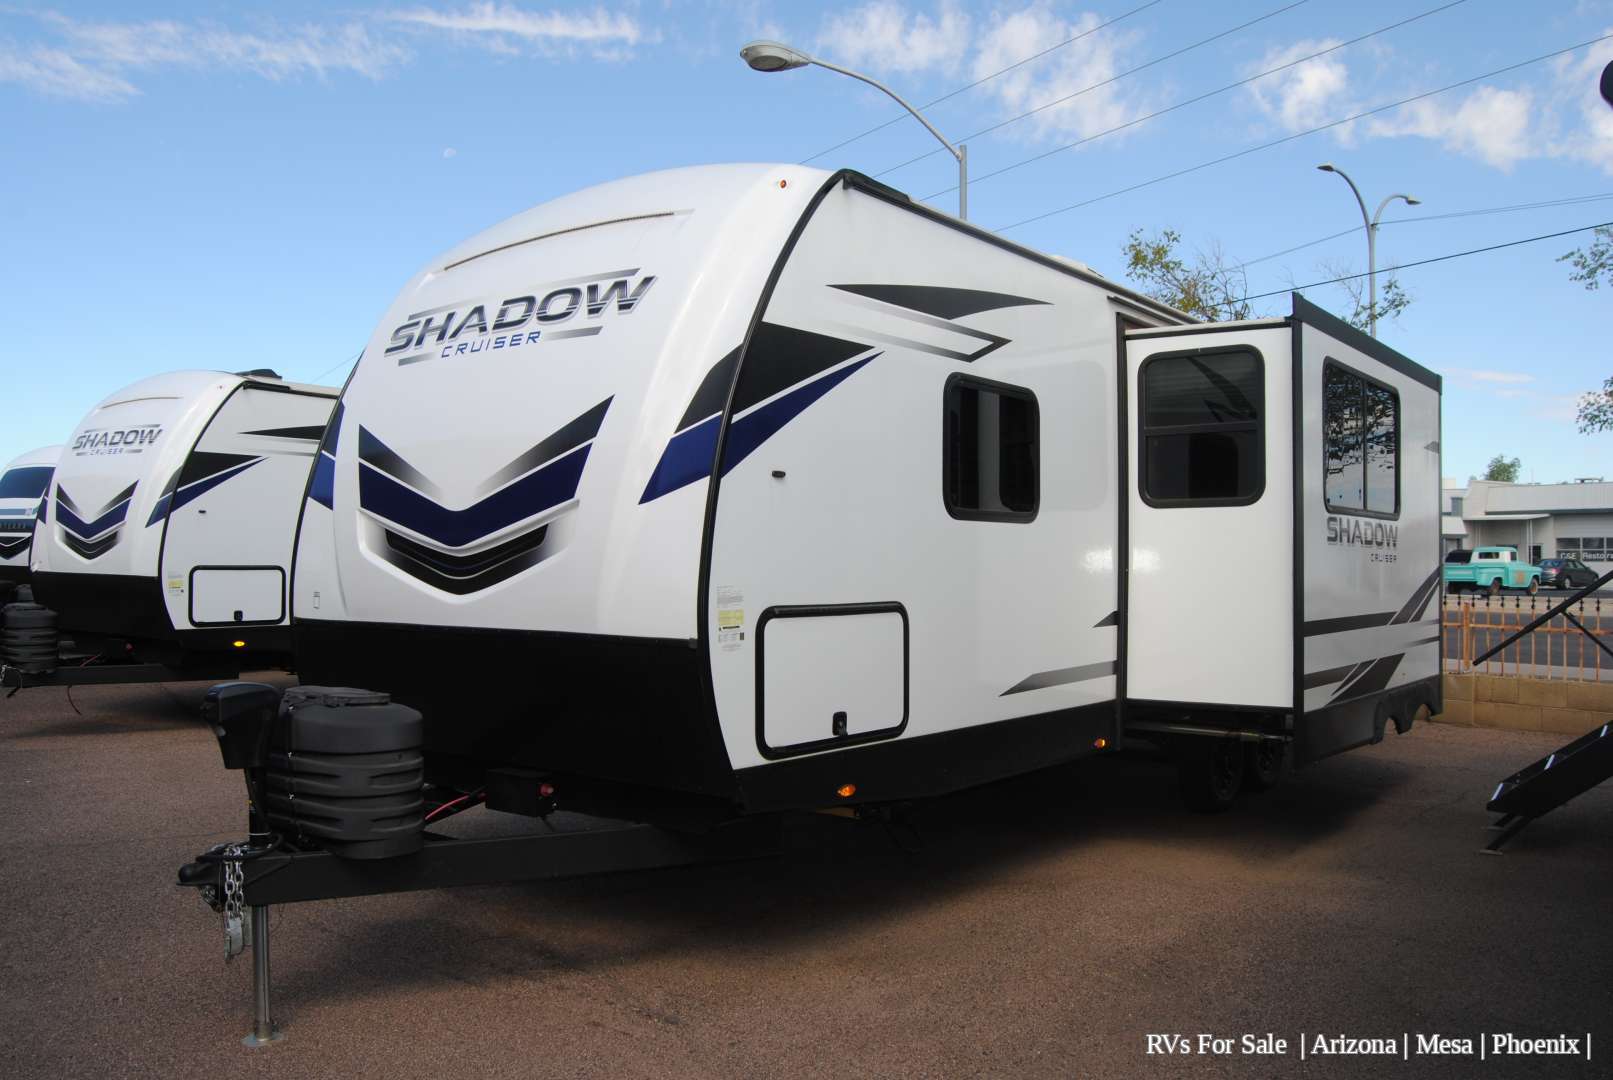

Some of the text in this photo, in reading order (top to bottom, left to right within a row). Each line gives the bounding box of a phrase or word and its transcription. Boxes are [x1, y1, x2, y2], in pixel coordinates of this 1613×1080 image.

[384, 275, 659, 357] SHADOW
[440, 329, 542, 358] CRUISER
[72, 428, 163, 449] SHADOW
[90, 447, 124, 456] CRUISER
[1327, 516, 1399, 547] SHADOW
[1369, 553, 1398, 563] CRUISER
